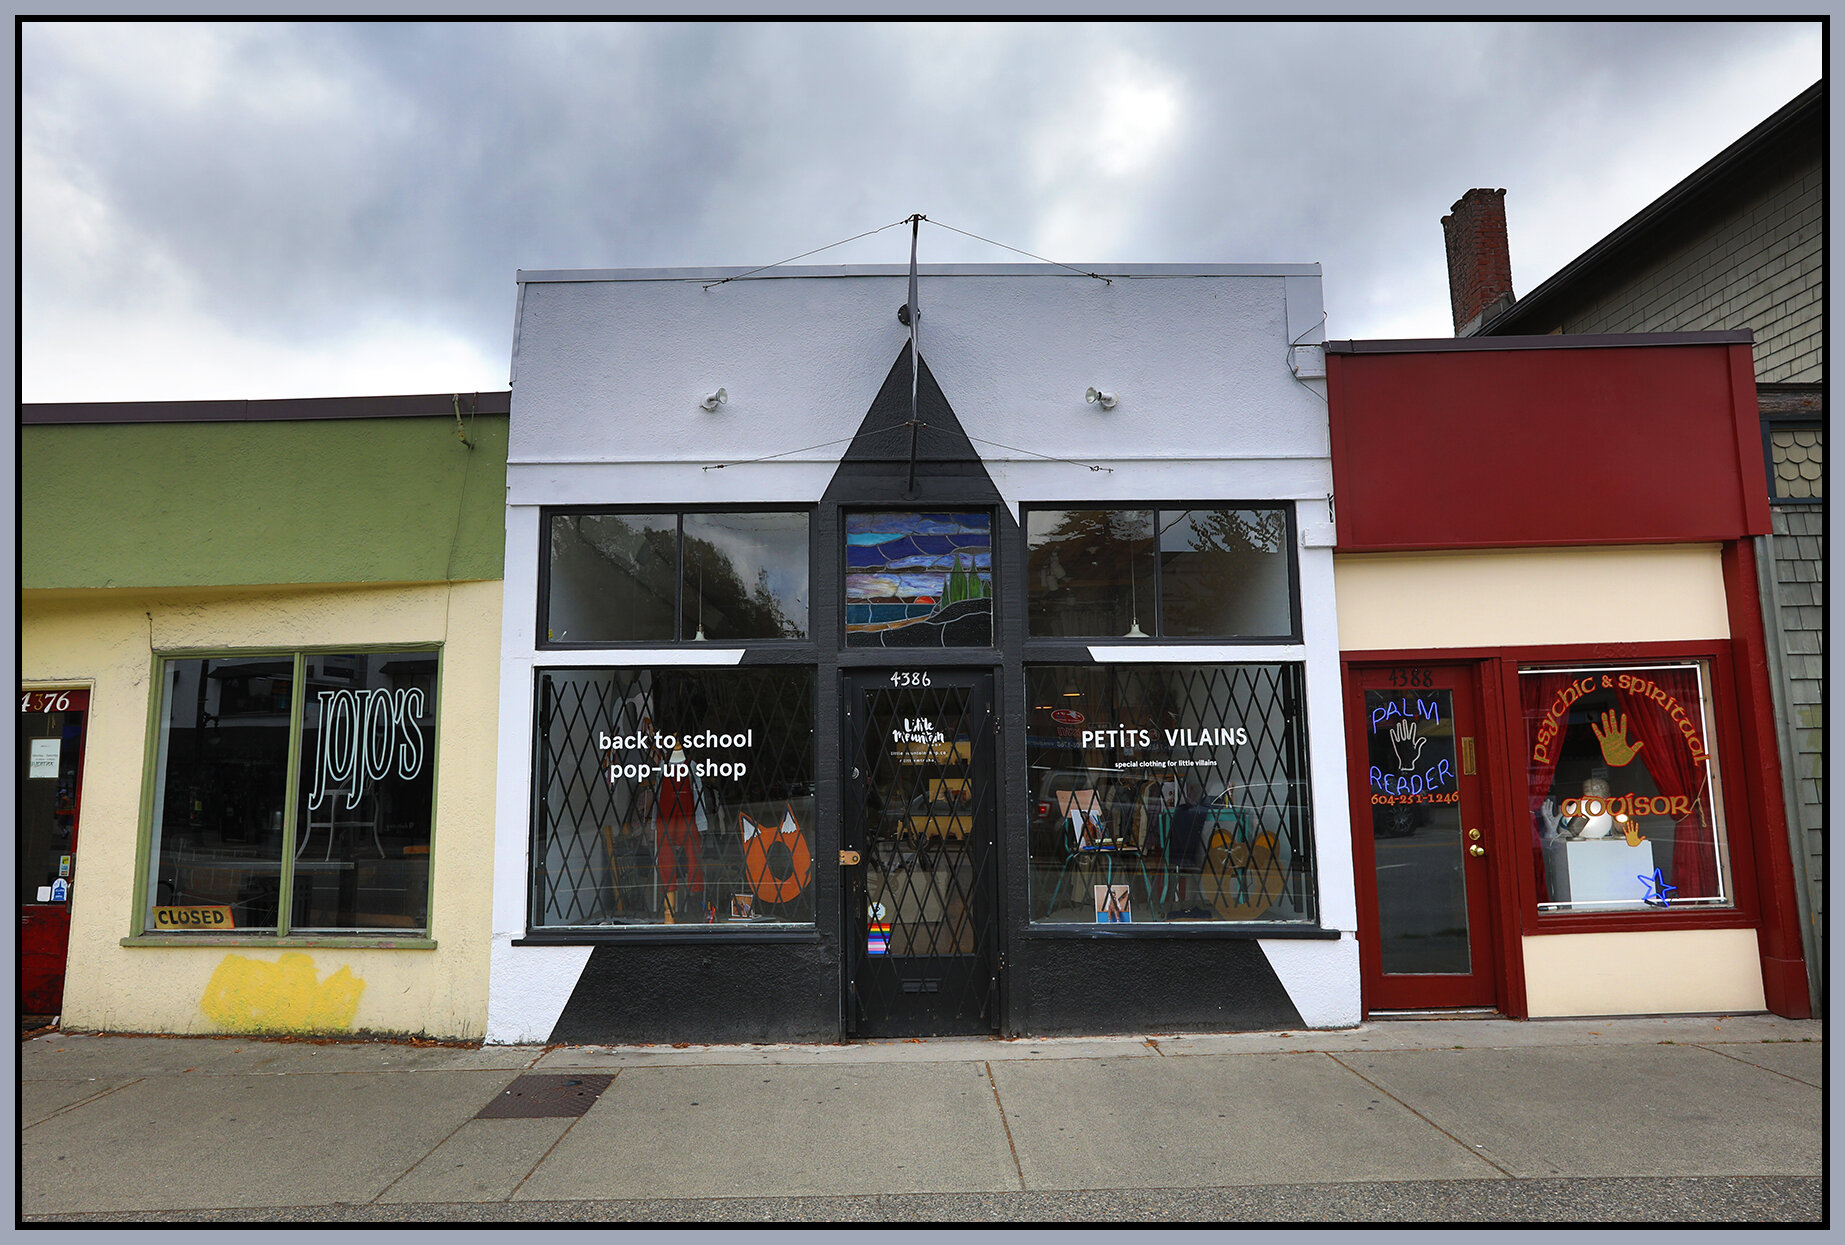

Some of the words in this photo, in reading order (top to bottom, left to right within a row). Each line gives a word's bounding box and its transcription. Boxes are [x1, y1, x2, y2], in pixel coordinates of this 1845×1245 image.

[890, 671, 931, 687] 4386
[1388, 669, 1433, 687] 4388
[1601, 674, 1613, 689] &
[22, 691, 70, 713] 4376
[1372, 698, 1439, 734] PALM
[600, 731, 649, 750] back
[654, 729, 676, 749] to
[682, 728, 752, 749] school
[1164, 727, 1247, 747] VILAINS
[308, 687, 424, 811] JOJO'S
[610, 762, 689, 783] pop-up
[695, 758, 747, 781] shop
[1114, 760, 1138, 768] special
[1139, 759, 1166, 769] clothing
[1178, 759, 1194, 767] little
[1195, 759, 1217, 767] villains
[1369, 759, 1454, 795] READER
[1371, 791, 1460, 806] 604-251-1246
[158, 910, 224, 925] CLOSED
